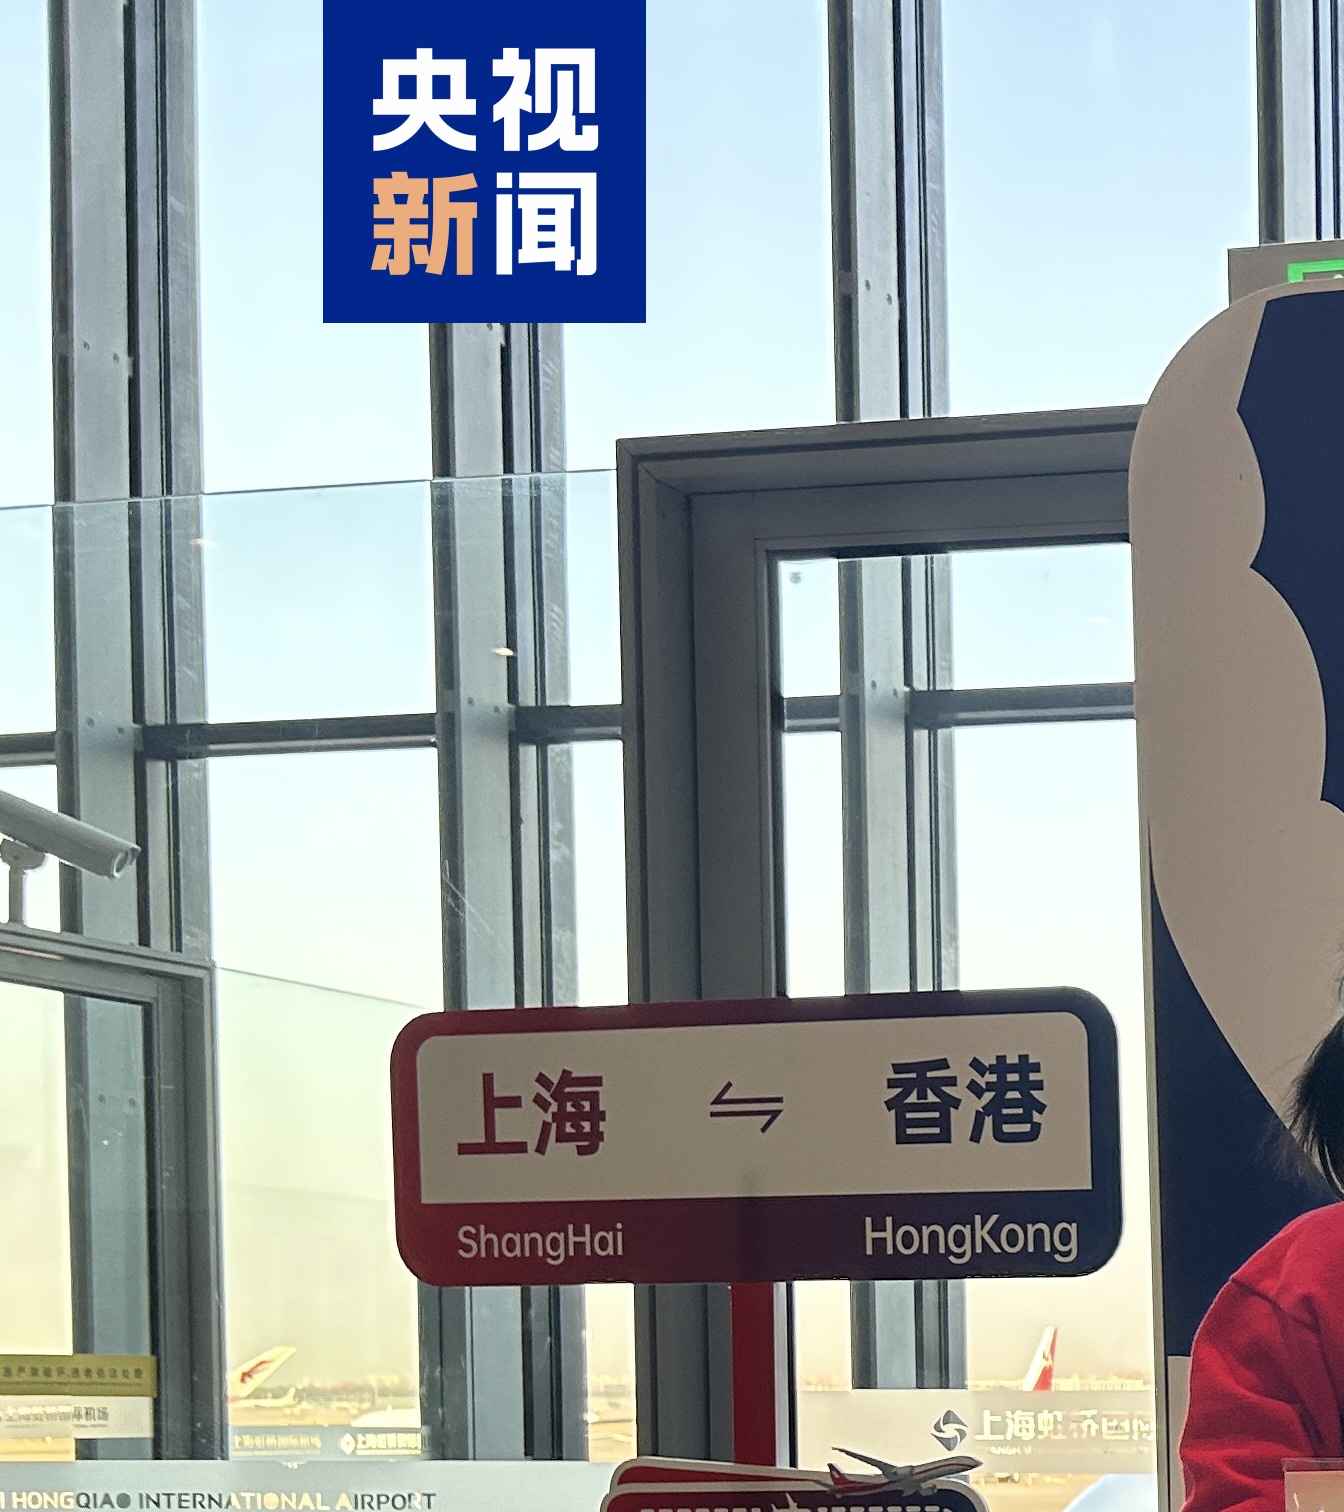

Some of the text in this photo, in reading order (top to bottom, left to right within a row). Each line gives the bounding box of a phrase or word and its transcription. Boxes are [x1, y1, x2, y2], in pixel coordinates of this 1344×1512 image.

[456, 1053, 1048, 1159] 上海 香港
[455, 1211, 1080, 1267] ShangHai HongKong
[12, 1491, 131, 1511] HONGQIAO
[139, 1491, 330, 1511] INTERNATIONAL
[335, 1491, 437, 1511] AIRPORT
